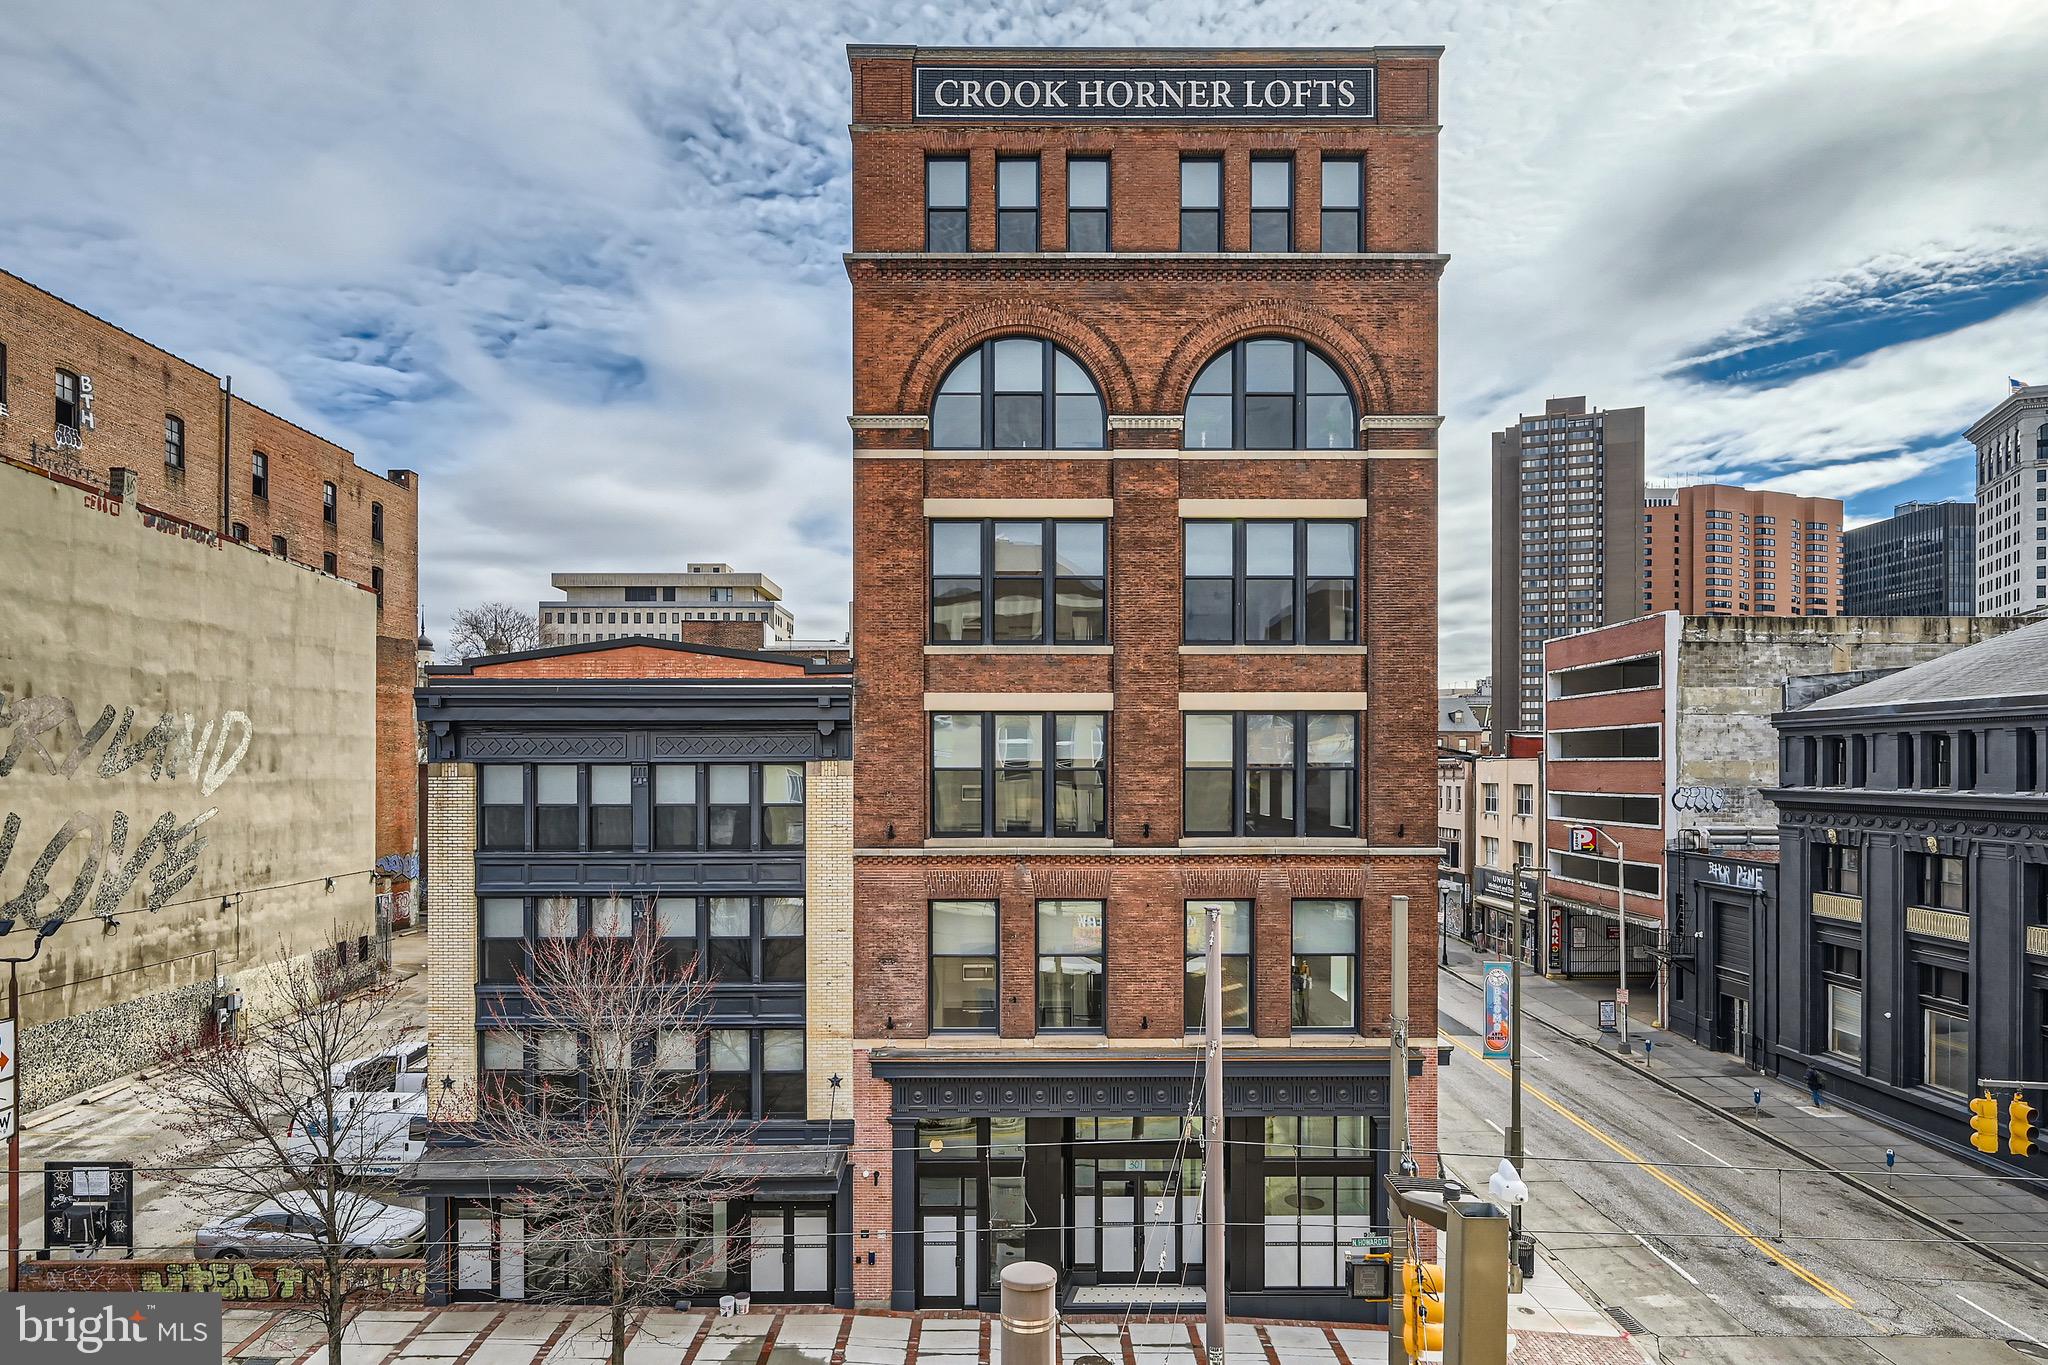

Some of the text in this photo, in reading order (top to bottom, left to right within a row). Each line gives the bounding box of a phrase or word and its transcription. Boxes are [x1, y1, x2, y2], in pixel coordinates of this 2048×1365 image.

[934, 79, 1356, 108] CROOK HORNER LOFTS
[1551, 909, 1562, 944] PARK
[1128, 1160, 1143, 1170] 301
[1358, 1239, 1383, 1247] HOWARD
